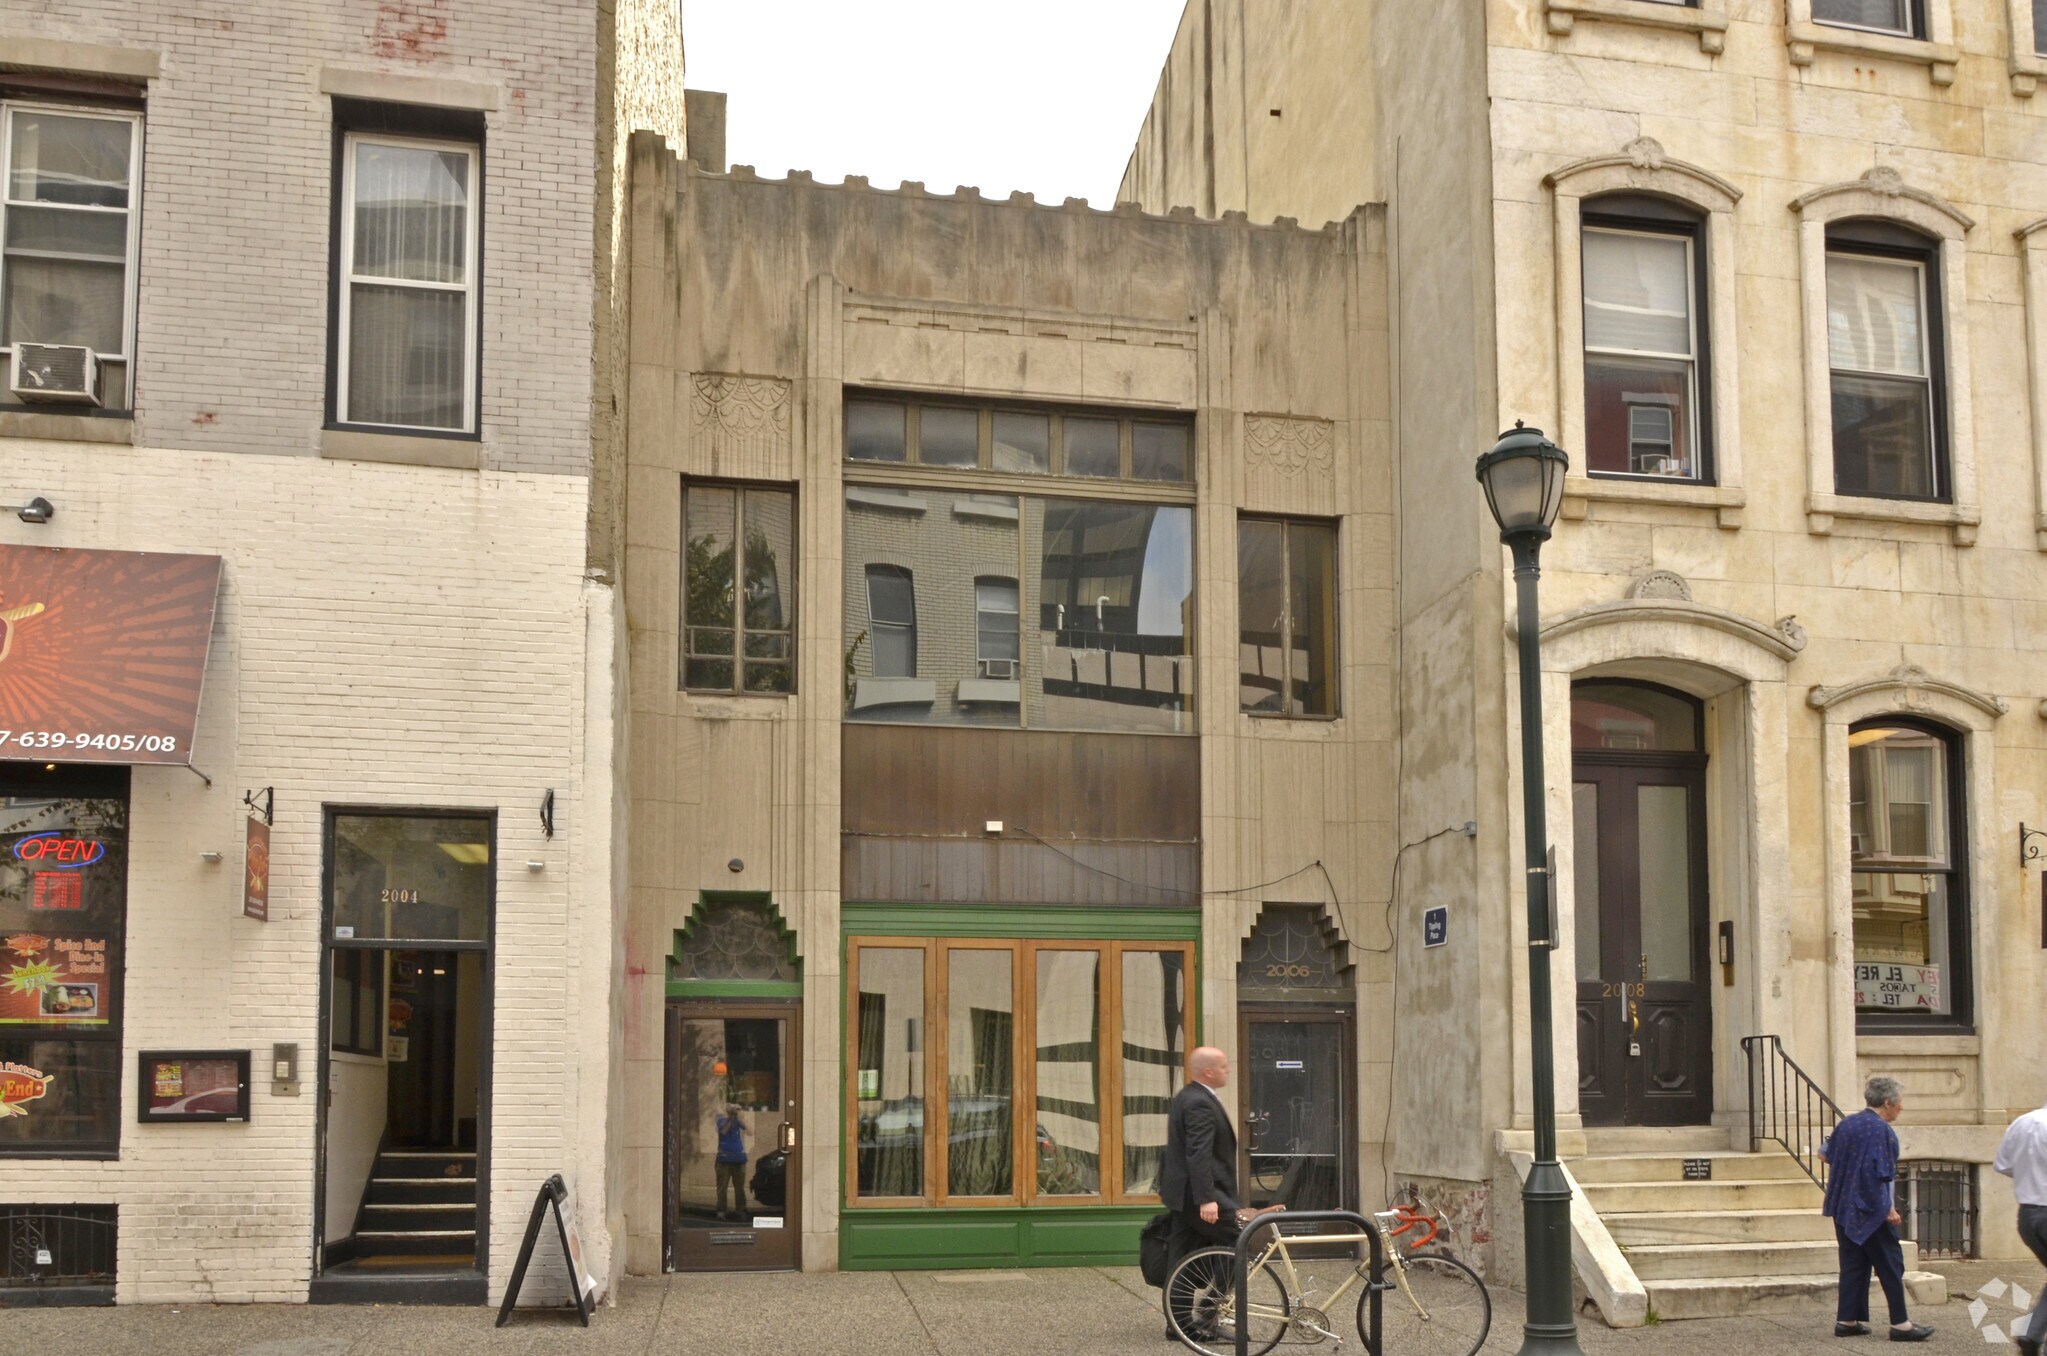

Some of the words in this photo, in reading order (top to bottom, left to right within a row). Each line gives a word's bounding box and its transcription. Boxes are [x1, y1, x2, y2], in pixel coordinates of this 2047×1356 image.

[20, 838, 97, 861] OPEN
[381, 889, 418, 903] 2004
[54, 938, 83, 952] Spice
[84, 939, 105, 951] End
[69, 950, 105, 962] Dine-in
[70, 961, 105, 974] Special
[1266, 964, 1310, 977] 2006
[1602, 982, 1645, 997] 2008
[5, 1062, 43, 1078] Platters
[6, 1080, 34, 1096] End
